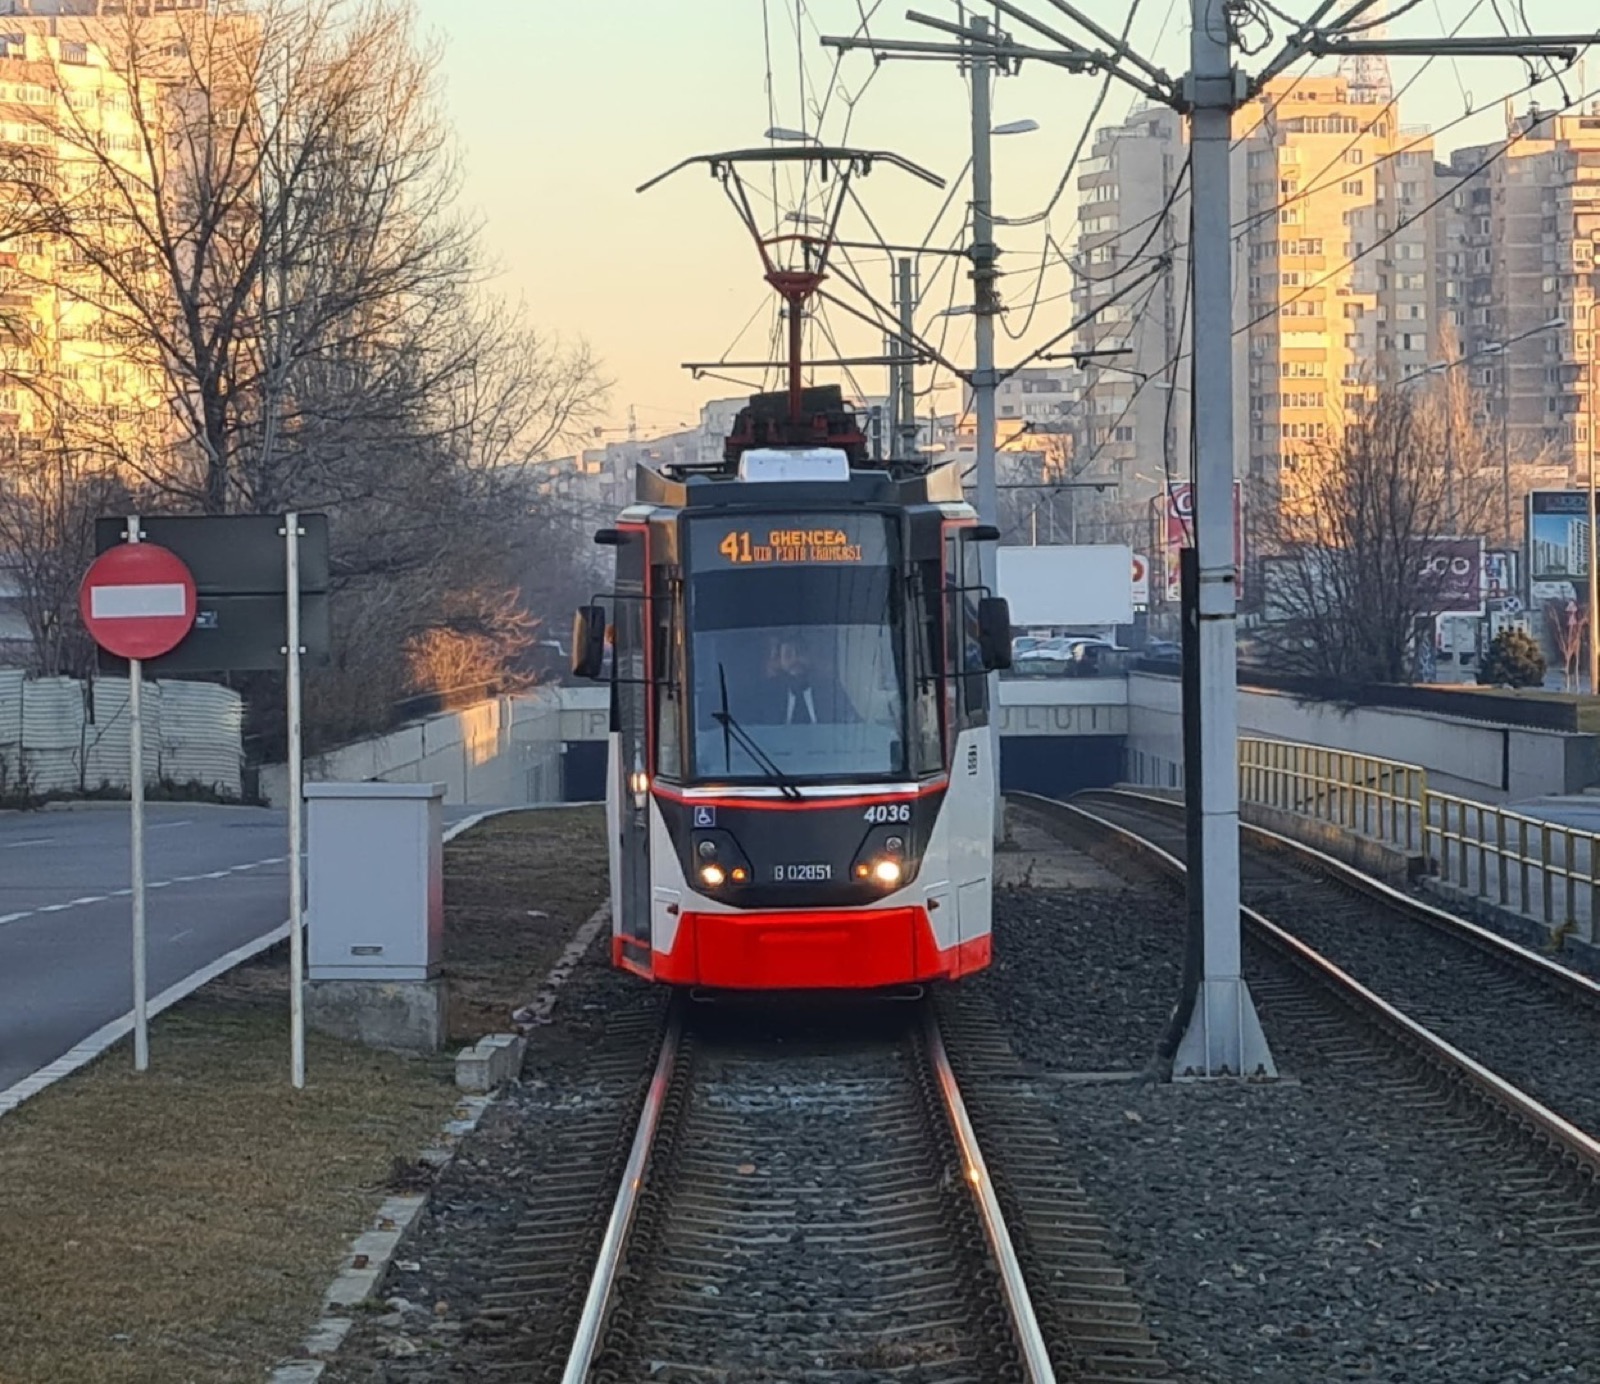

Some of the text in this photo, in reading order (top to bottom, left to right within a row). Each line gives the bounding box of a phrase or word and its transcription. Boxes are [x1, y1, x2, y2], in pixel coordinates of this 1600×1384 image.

[769, 529, 847, 545] GHENCEA
[720, 531, 752, 563] 41
[864, 805, 910, 822] 4036
[775, 864, 831, 881] B 02851
